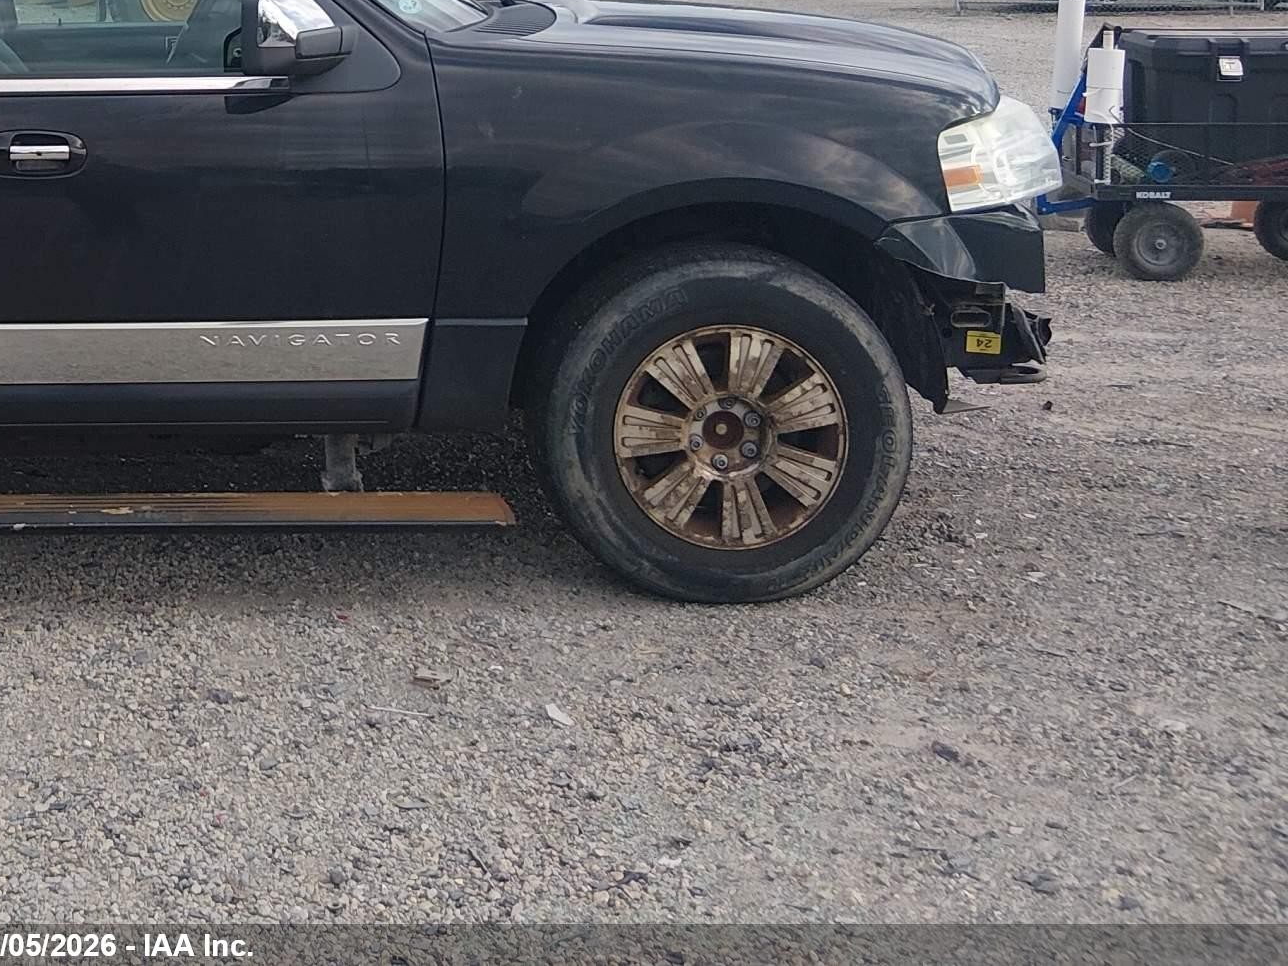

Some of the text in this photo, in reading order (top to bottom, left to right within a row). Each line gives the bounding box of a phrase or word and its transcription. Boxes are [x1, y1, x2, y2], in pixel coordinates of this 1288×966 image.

[1135, 191, 1172, 199] KOBALT
[199, 332, 402, 347] NAVIGATOR
[975, 338, 993, 349] 24
[568, 286, 689, 434] YOKOHAMA
